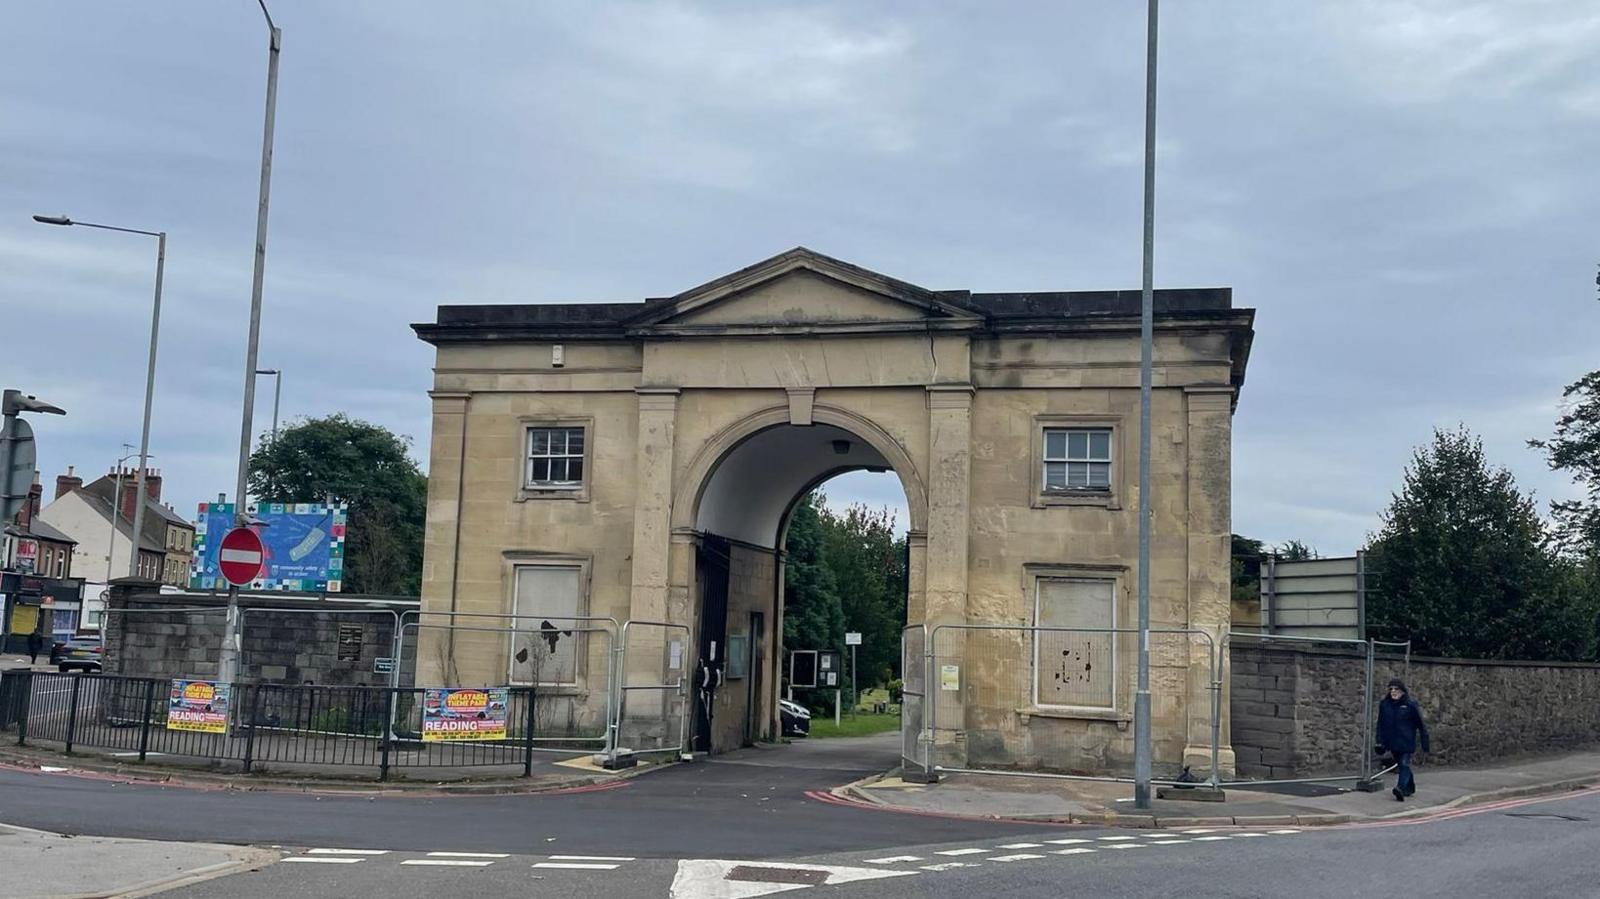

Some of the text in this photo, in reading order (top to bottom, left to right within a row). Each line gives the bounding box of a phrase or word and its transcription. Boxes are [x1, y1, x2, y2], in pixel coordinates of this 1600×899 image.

[448, 692, 488, 700] INFLATABLE
[169, 711, 205, 722] READING
[425, 721, 478, 731] READING
